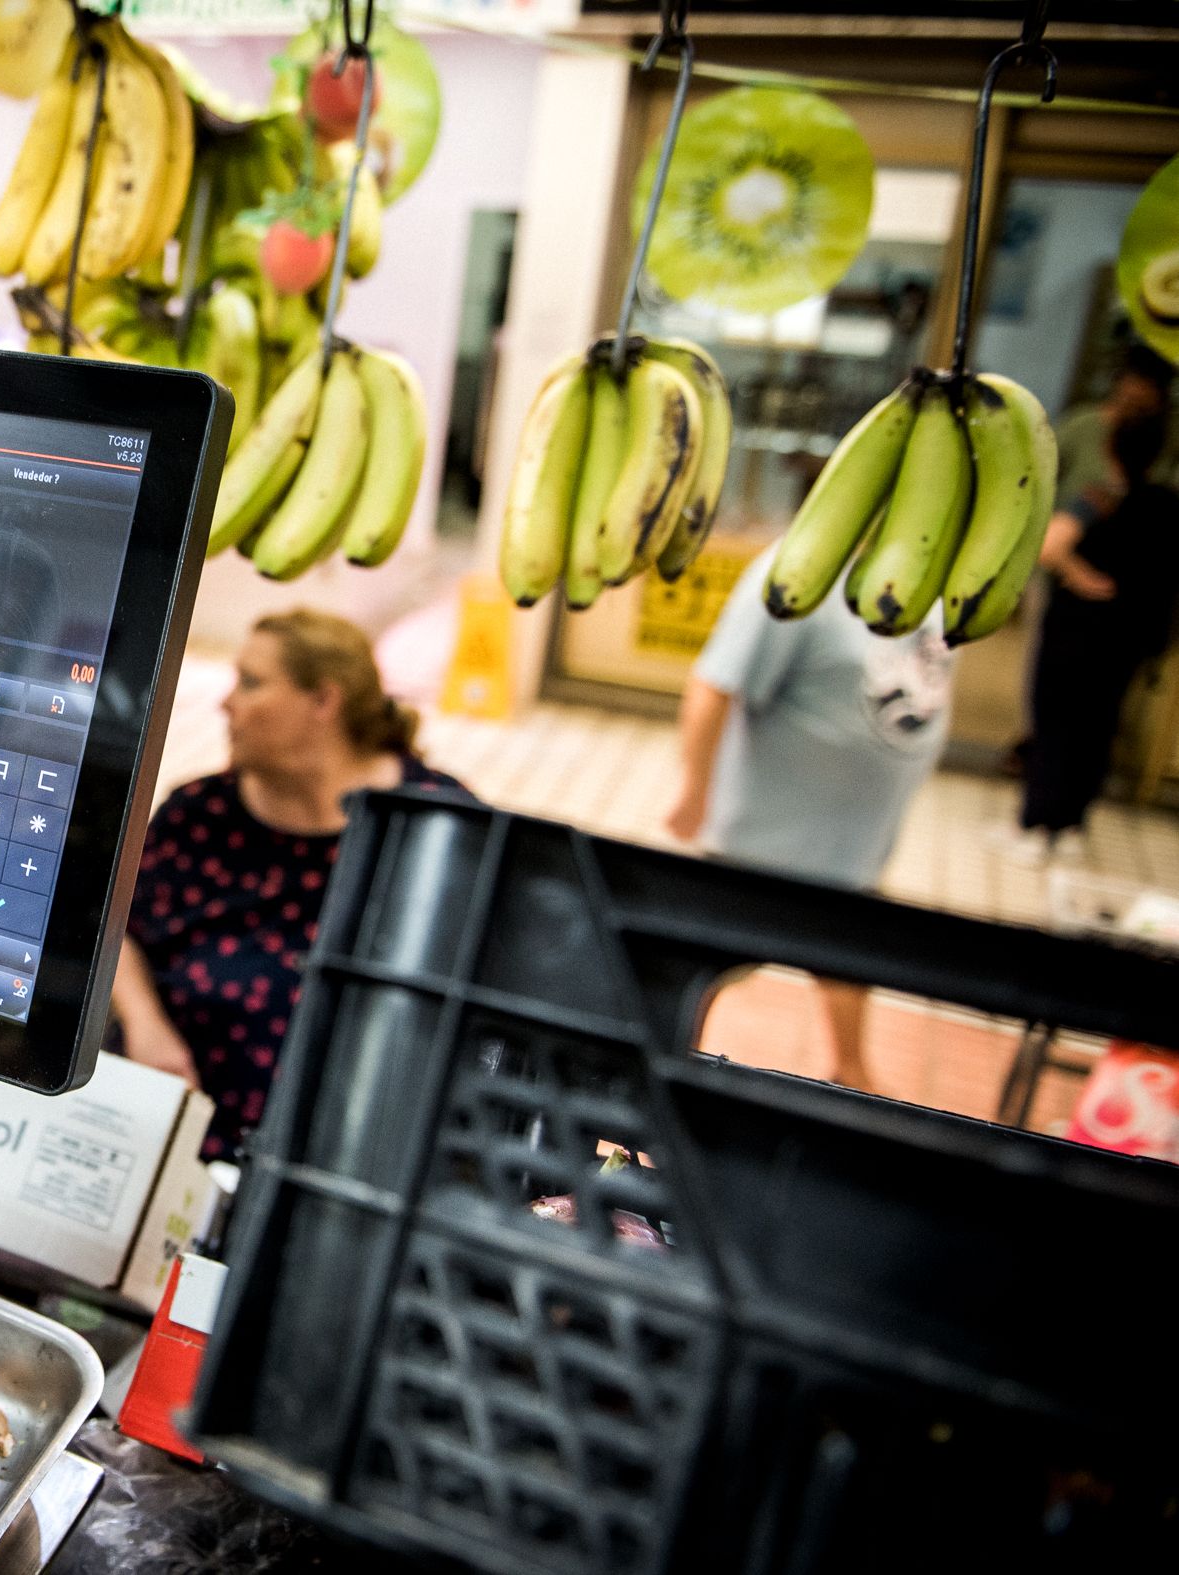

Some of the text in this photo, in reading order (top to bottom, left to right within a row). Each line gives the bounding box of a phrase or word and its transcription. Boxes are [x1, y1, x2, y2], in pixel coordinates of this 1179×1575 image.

[108, 435, 145, 450] TC8611
[117, 451, 143, 464] v5.23
[13, 467, 60, 484] Vendedor ?
[71, 663, 95, 684] 0,00
[37, 769, 58, 793] C
